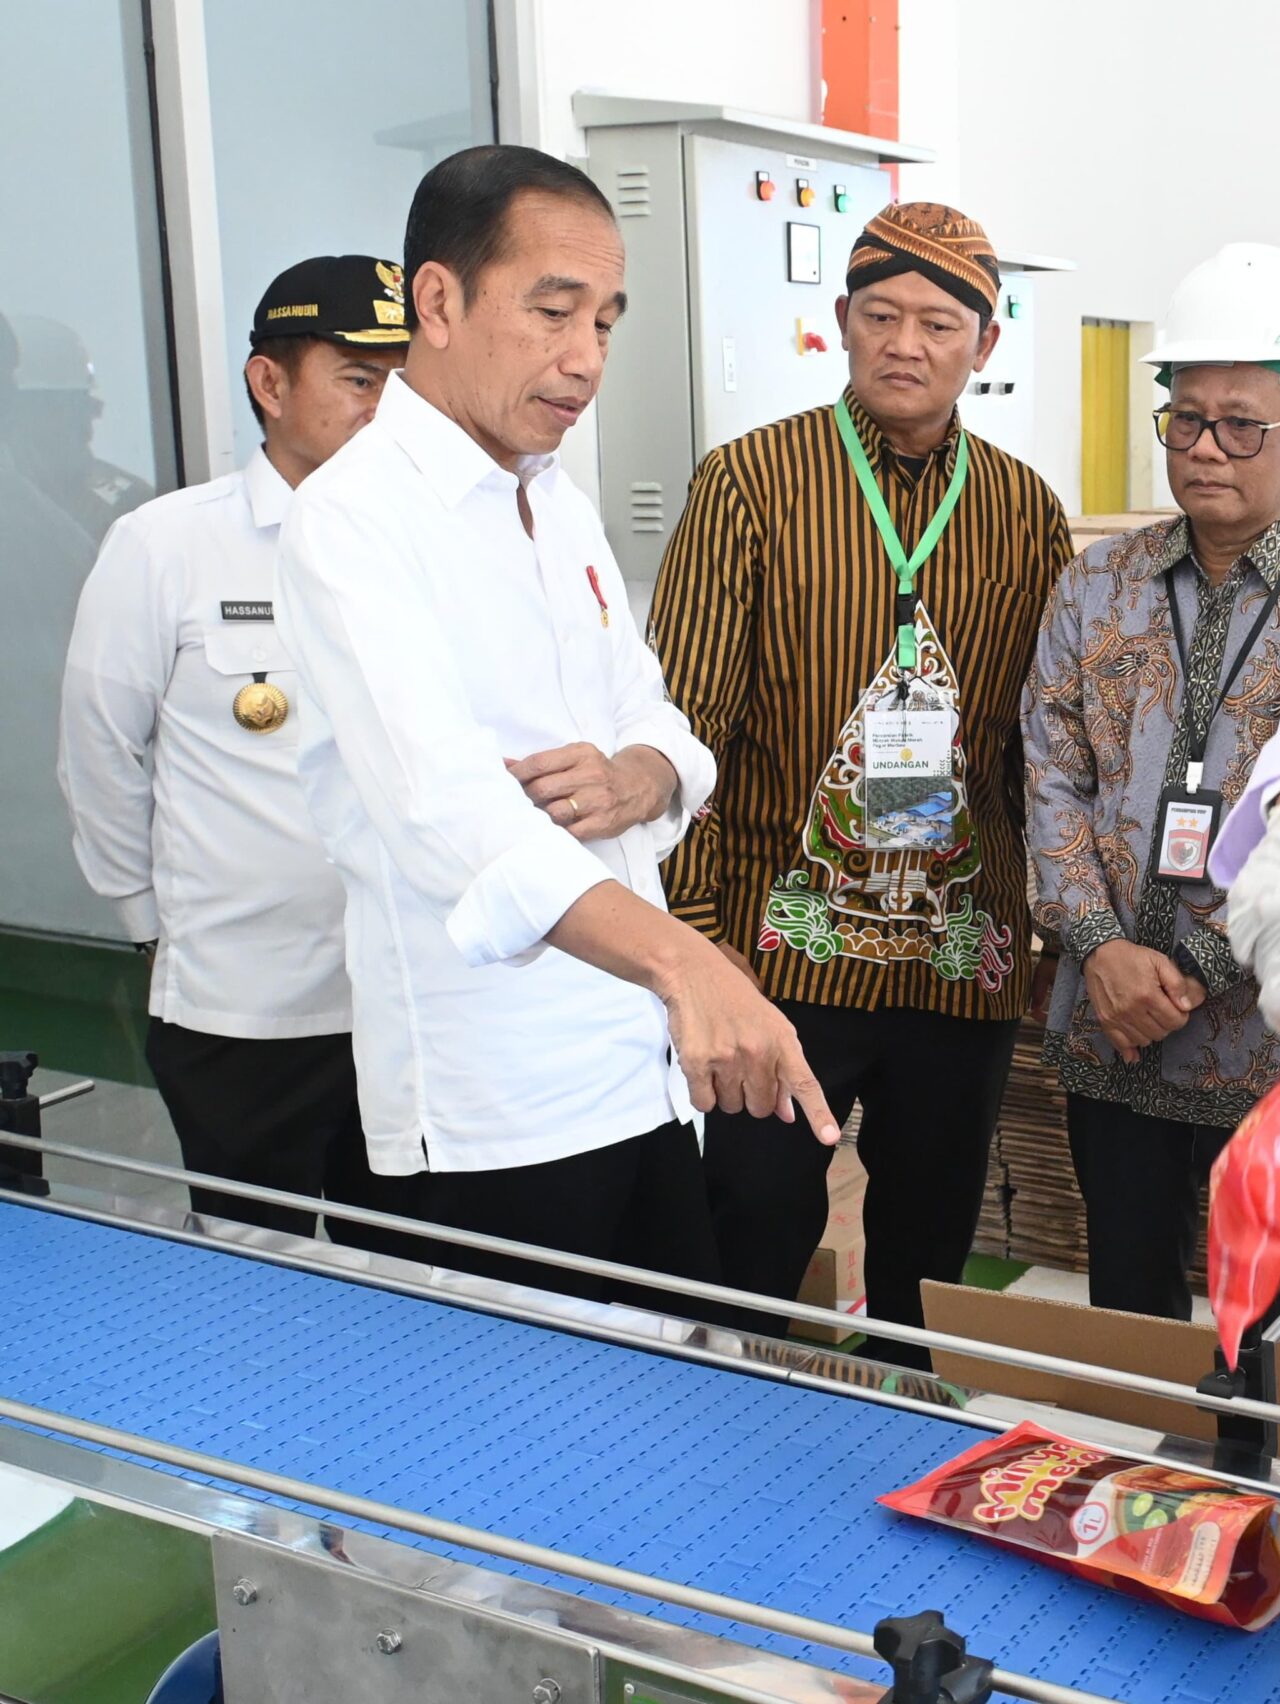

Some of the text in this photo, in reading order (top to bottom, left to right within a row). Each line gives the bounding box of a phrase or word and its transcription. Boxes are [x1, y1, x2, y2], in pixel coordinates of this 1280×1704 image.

[266, 303, 319, 320] HASSANUDIN
[224, 605, 273, 616] HASSANU
[872, 760, 929, 770] UNDANGAN
[975, 1441, 1074, 1521] Minya
